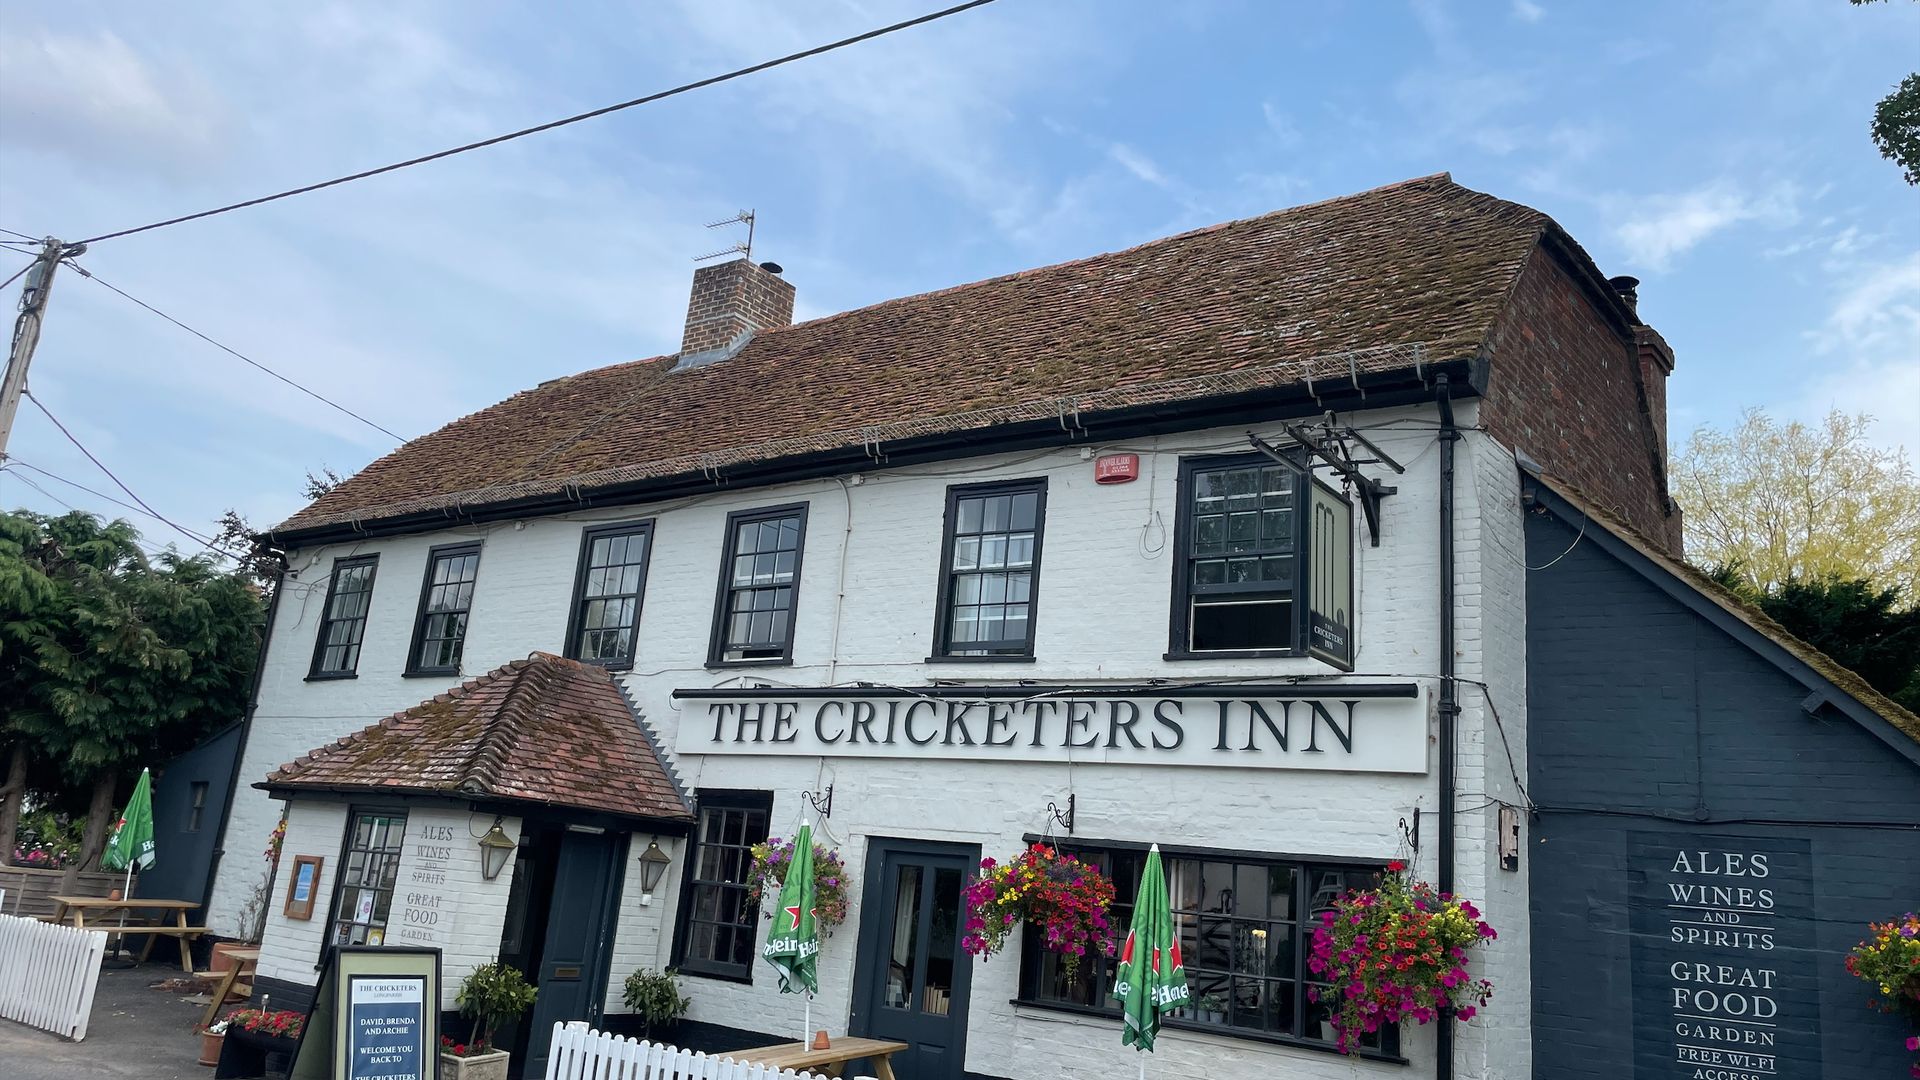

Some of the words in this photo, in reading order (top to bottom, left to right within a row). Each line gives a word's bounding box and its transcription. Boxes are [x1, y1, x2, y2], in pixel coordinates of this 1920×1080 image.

[1313, 625, 1344, 646] CRICKETERS
[708, 702, 799, 742] THE
[814, 700, 1185, 750] CRICKETERS
[1211, 700, 1361, 754] INN
[420, 825, 454, 842] ALES
[417, 845, 451, 860] WINES
[424, 862, 437, 870] AND
[1670, 850, 1769, 878] ALES
[412, 872, 445, 885] SPIRITS
[407, 892, 442, 908] GREAT
[1667, 883, 1775, 909] WINES
[404, 908, 438, 926] FOOD
[1703, 912, 1740, 924] AND
[401, 929, 433, 942] GARDEN
[1671, 926, 1775, 950] SPIRITS
[1670, 961, 1776, 989] GREAT
[374, 984, 417, 992] CRICKETERS
[1672, 987, 1777, 1018] FOOD
[360, 1018, 386, 1026] DAVID,
[386, 1017, 416, 1025] BRENDA
[1675, 1022, 1775, 1046] GARDEN
[397, 1045, 413, 1053] YOU
[370, 1056, 391, 1064] BACK
[392, 1055, 402, 1063] TO
[1678, 1047, 1722, 1064] FREE
[1728, 1053, 1775, 1070] WI-FI
